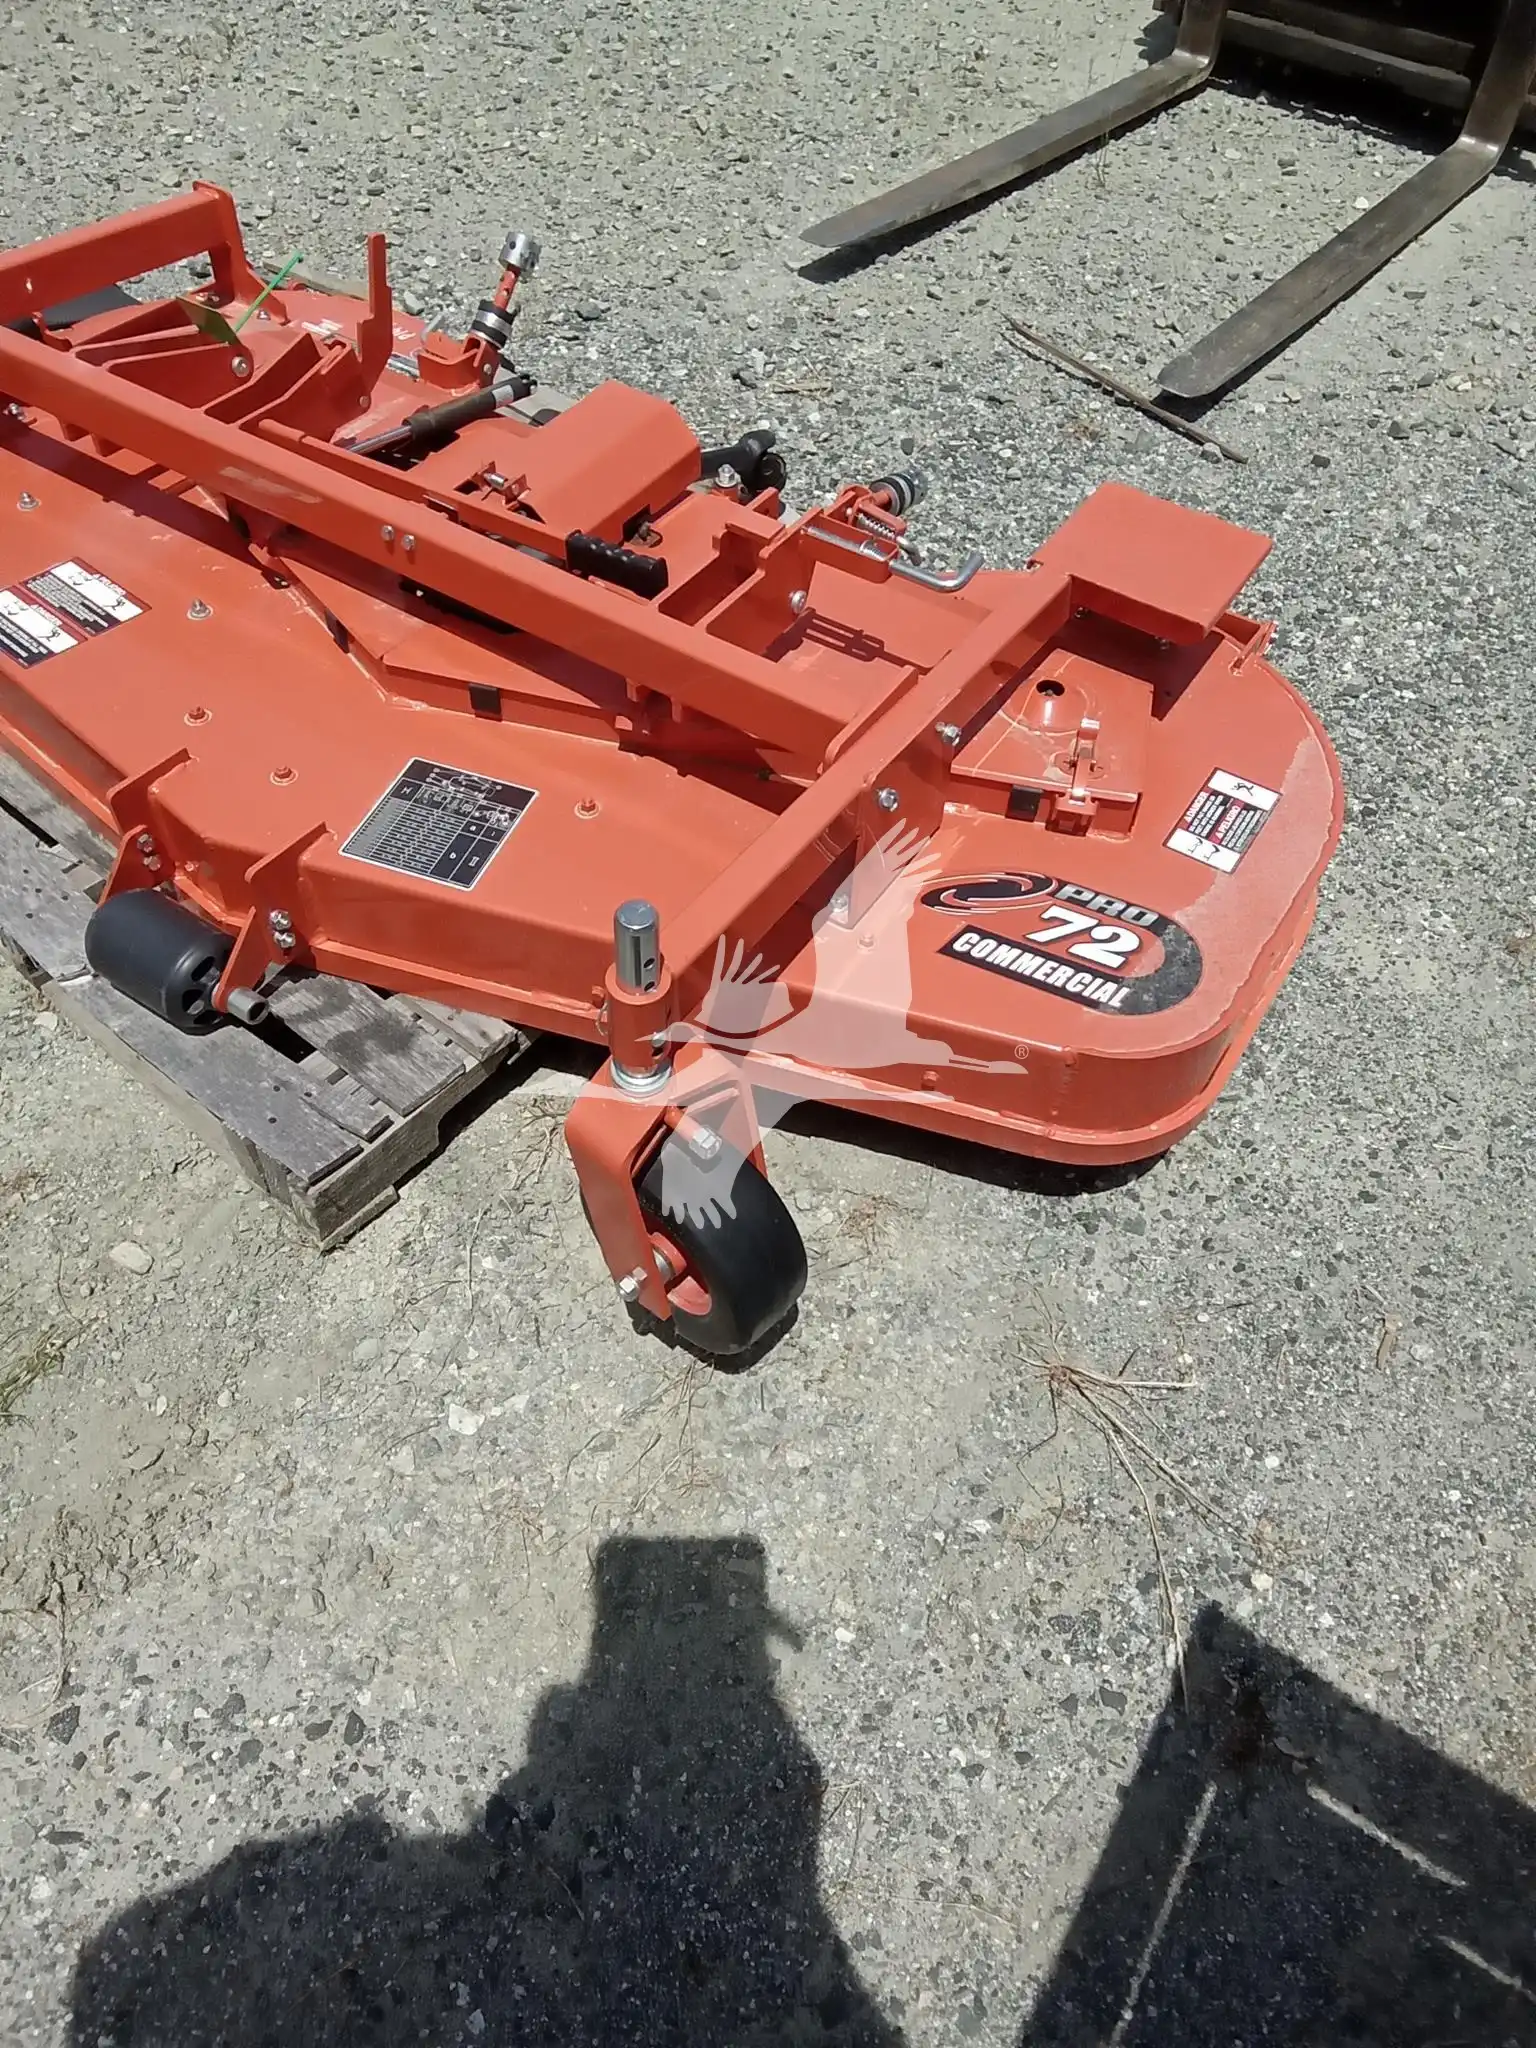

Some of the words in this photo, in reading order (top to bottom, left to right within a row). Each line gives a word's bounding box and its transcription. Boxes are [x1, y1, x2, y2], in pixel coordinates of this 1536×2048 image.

[1024, 905, 1141, 969] 72
[1053, 884, 1160, 927] PRO
[952, 931, 1133, 1008] COMMERCIAL
